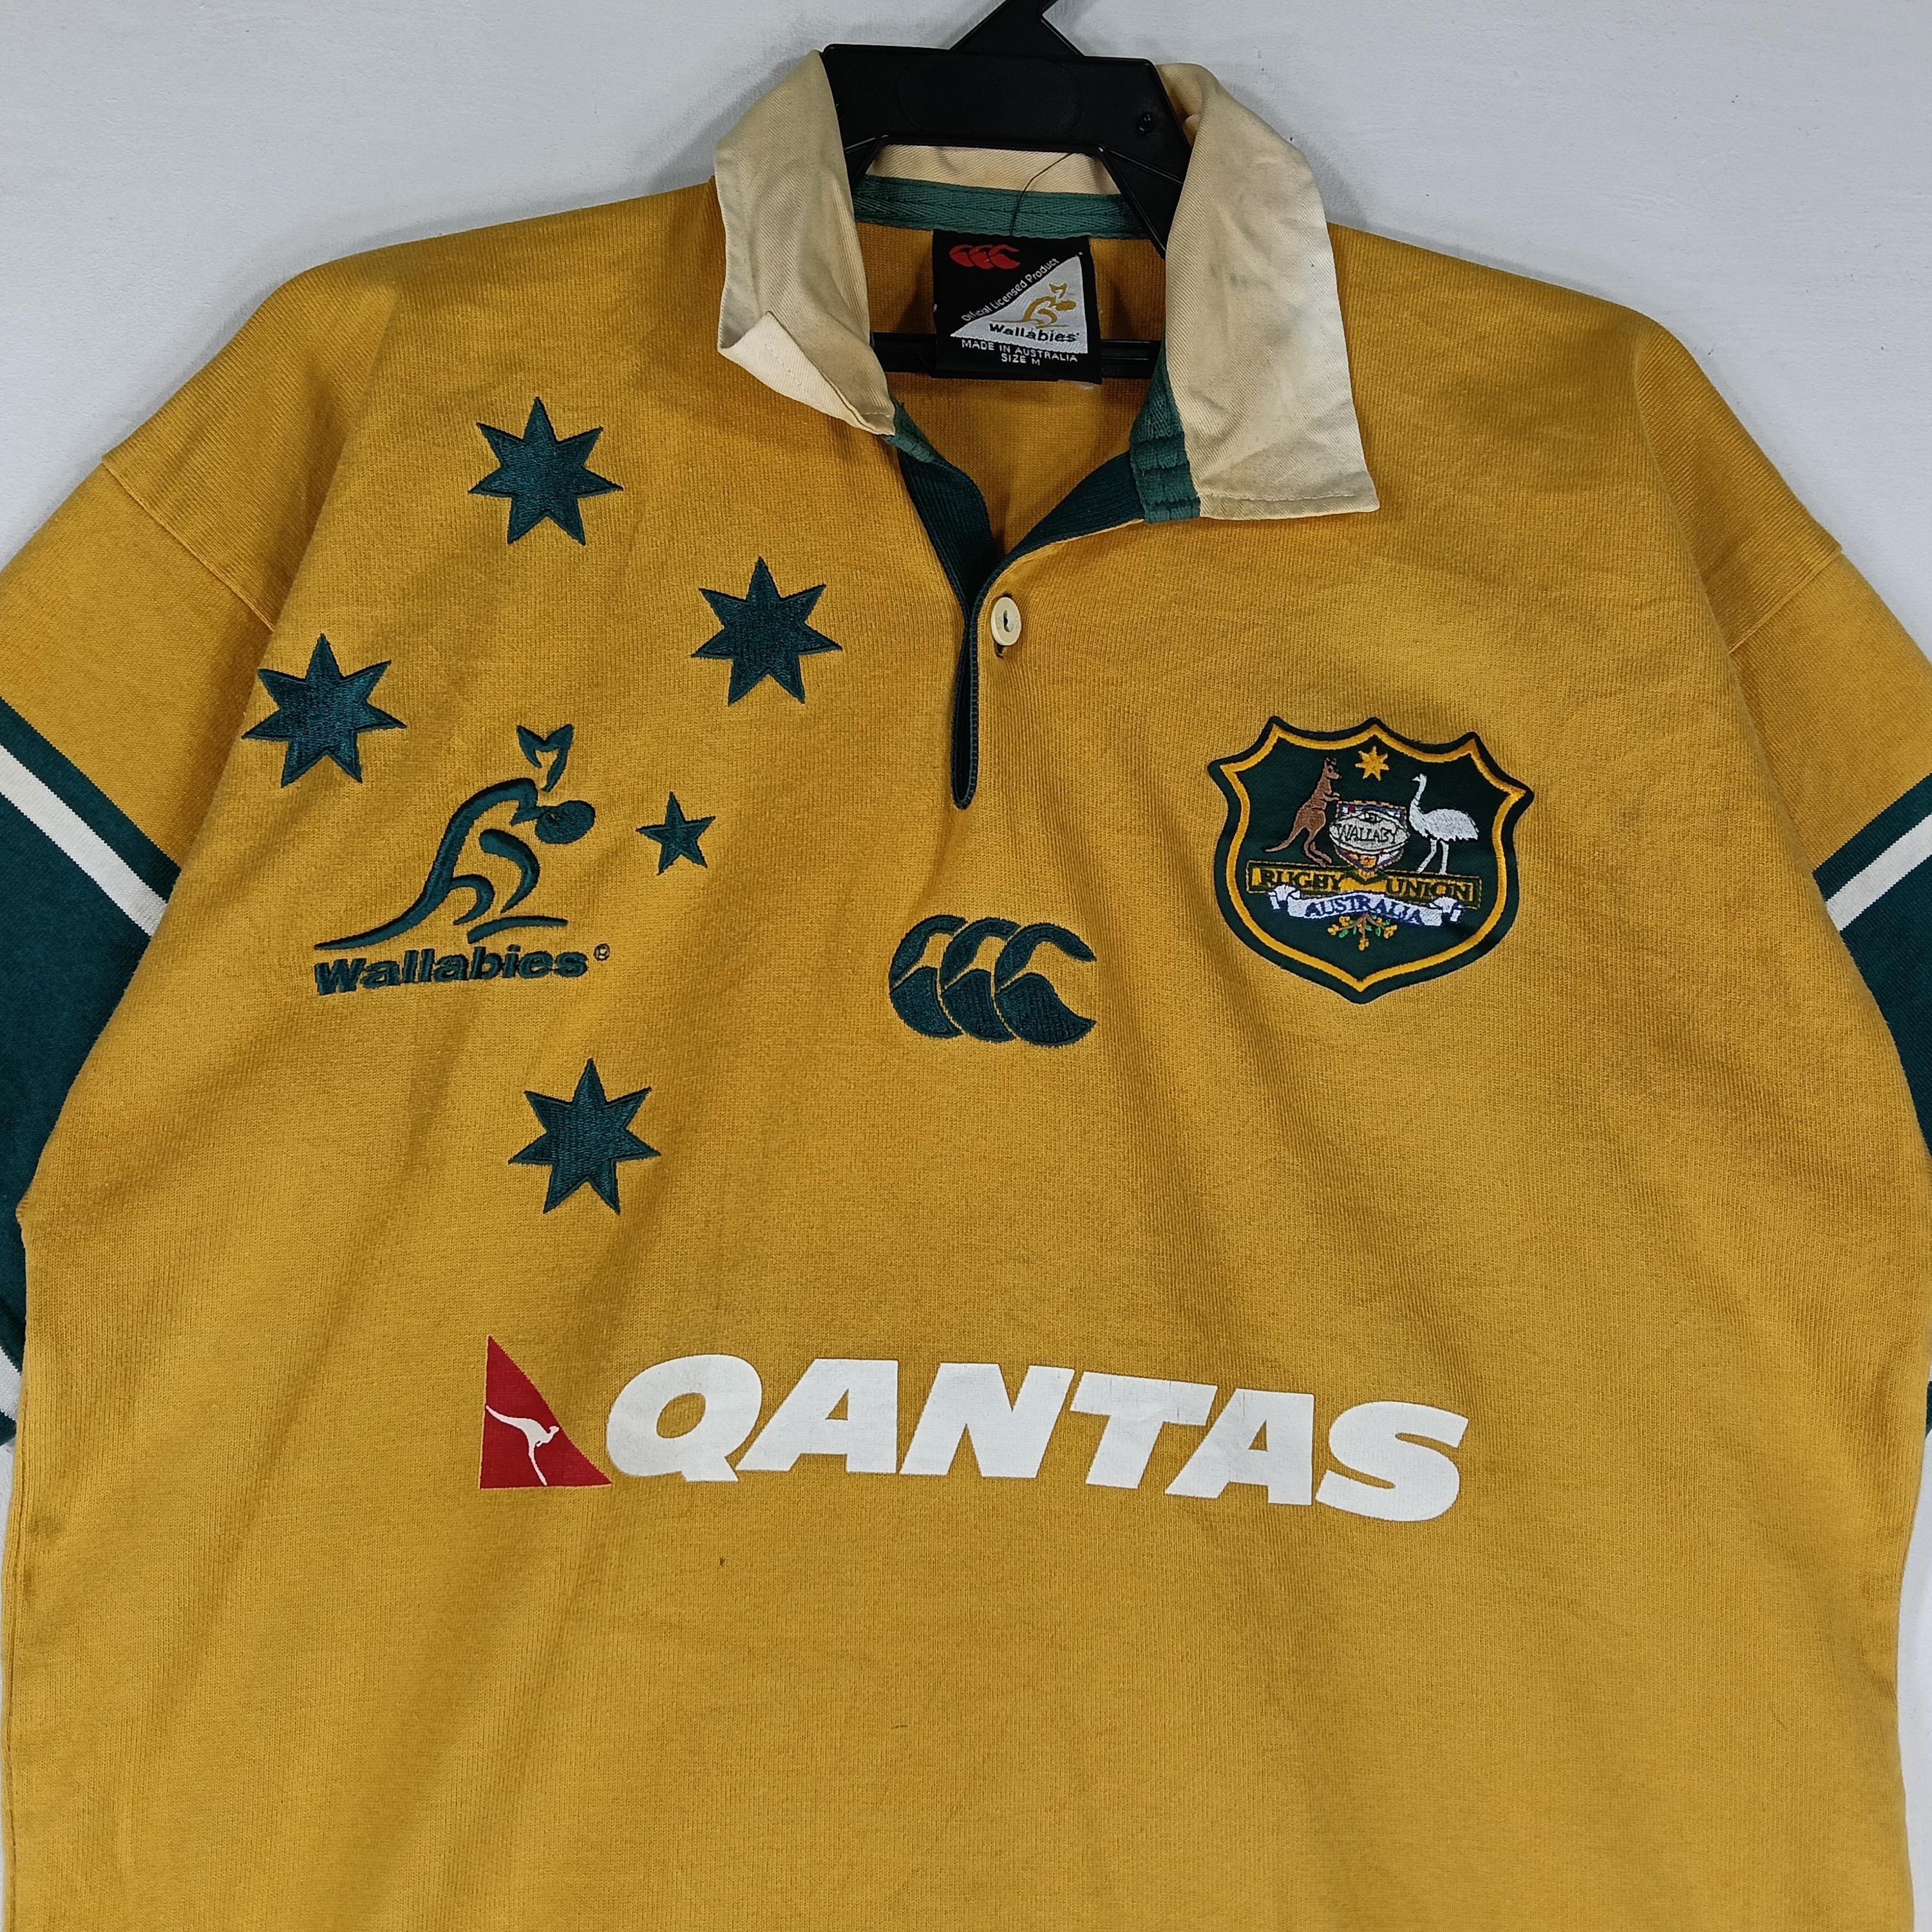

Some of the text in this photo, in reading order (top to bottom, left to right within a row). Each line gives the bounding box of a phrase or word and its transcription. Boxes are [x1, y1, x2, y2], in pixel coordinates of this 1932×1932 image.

[961, 258, 1060, 321] Official Licensed Product
[989, 323, 1077, 343] Wallabies
[961, 339, 995, 351] MADE
[1014, 346, 1078, 362] AUSTRALIA
[1001, 354, 1027, 364] SIZE
[1335, 824, 1397, 844] WALLABY
[1260, 869, 1473, 900] RUGBY UNION
[1304, 895, 1423, 925] AUSTRALIA
[605, 1353, 1469, 1522] QANTAS
